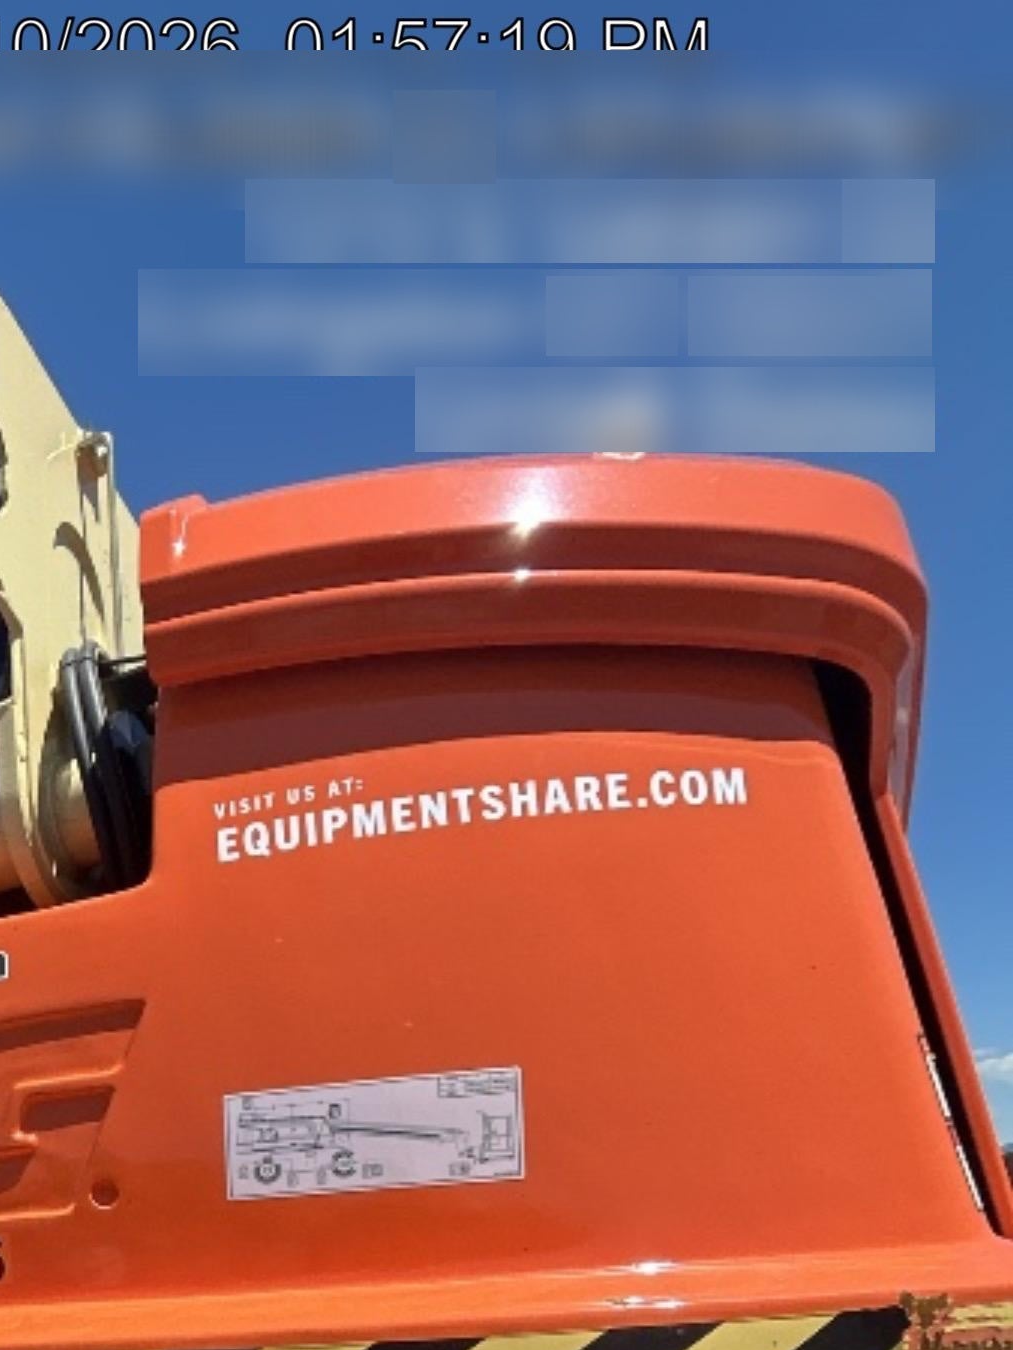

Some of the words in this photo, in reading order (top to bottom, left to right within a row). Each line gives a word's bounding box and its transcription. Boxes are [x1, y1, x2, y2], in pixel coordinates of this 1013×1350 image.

[214, 792, 275, 819] VISIT
[286, 785, 315, 805] US
[217, 768, 747, 863] EQUIPMENTSHARE.COM
